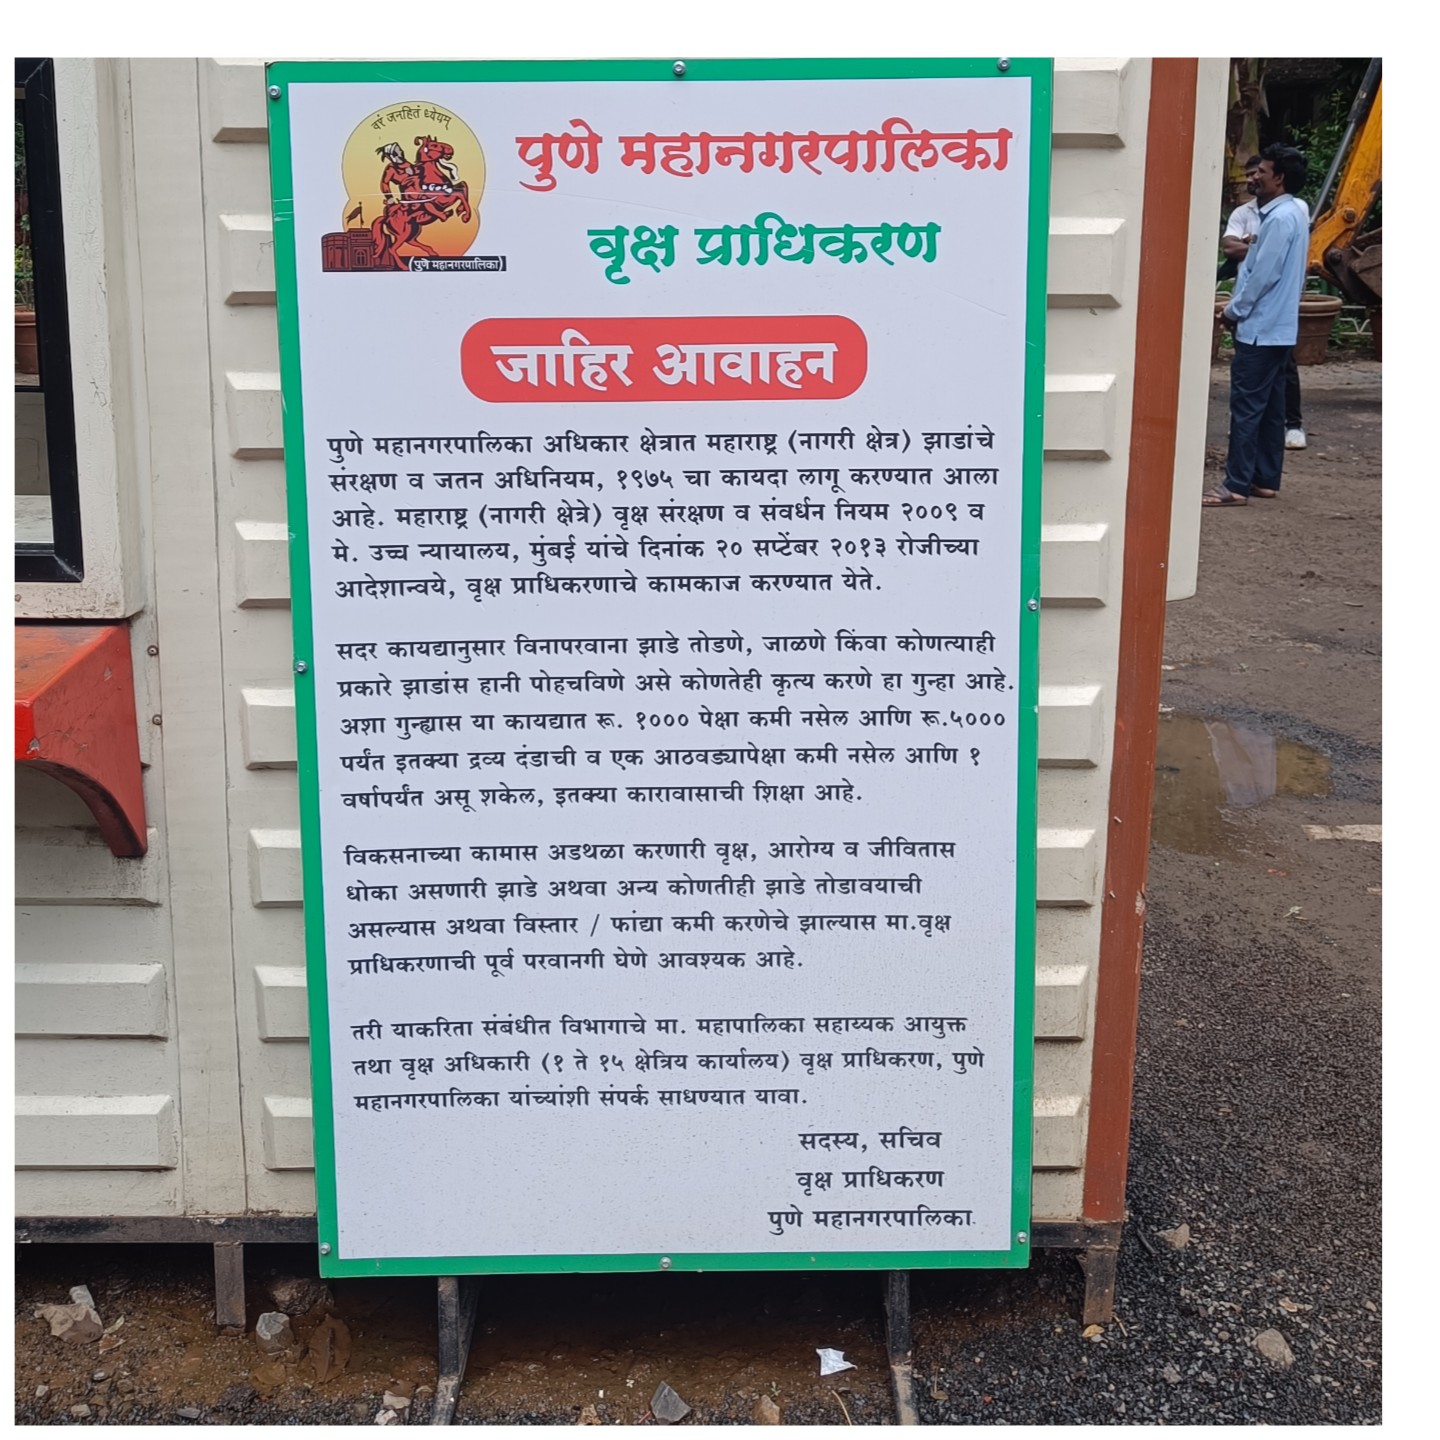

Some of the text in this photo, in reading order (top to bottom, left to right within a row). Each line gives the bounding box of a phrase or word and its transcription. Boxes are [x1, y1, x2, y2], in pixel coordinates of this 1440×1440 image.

[515, 117, 1013, 193] पुणे महानगरपालिका
[586, 211, 942, 286] वृक्ष प्राधिकरण
[489, 328, 839, 392] जाहिर आवाहन
[325, 423, 996, 464] पुणे महानगरपालिका अधिकार क्षेत्रात महाराष्ट्र (नागरी क्षेत्र) झाडांचे
[327, 464, 1000, 494] संरक्षण व जतन अधिनियम, १९७५ चा कायदा लागू करण्यात आला
[334, 565, 882, 603] आदेशान्वये, वृक्ष प्राधिकरणाचे कामकाज करण्यात येते.
[334, 627, 997, 664] सदर कायद्यानुसार विनापरवाना झाडे तोडणे, जाळणे किंवा कोणत्याही
[339, 777, 862, 813] वर्षापर्यंत असू शकेल, इतक्या कारावासाची शिक्षा आहे.
[352, 1083, 808, 1113] महानगरपालिका यांच्यांशी संपर्क साधण्यात यावा.
[797, 1125, 943, 1154] सदस्य, सचिव
[766, 1204, 973, 1235] पुणे महानगरपालिका
